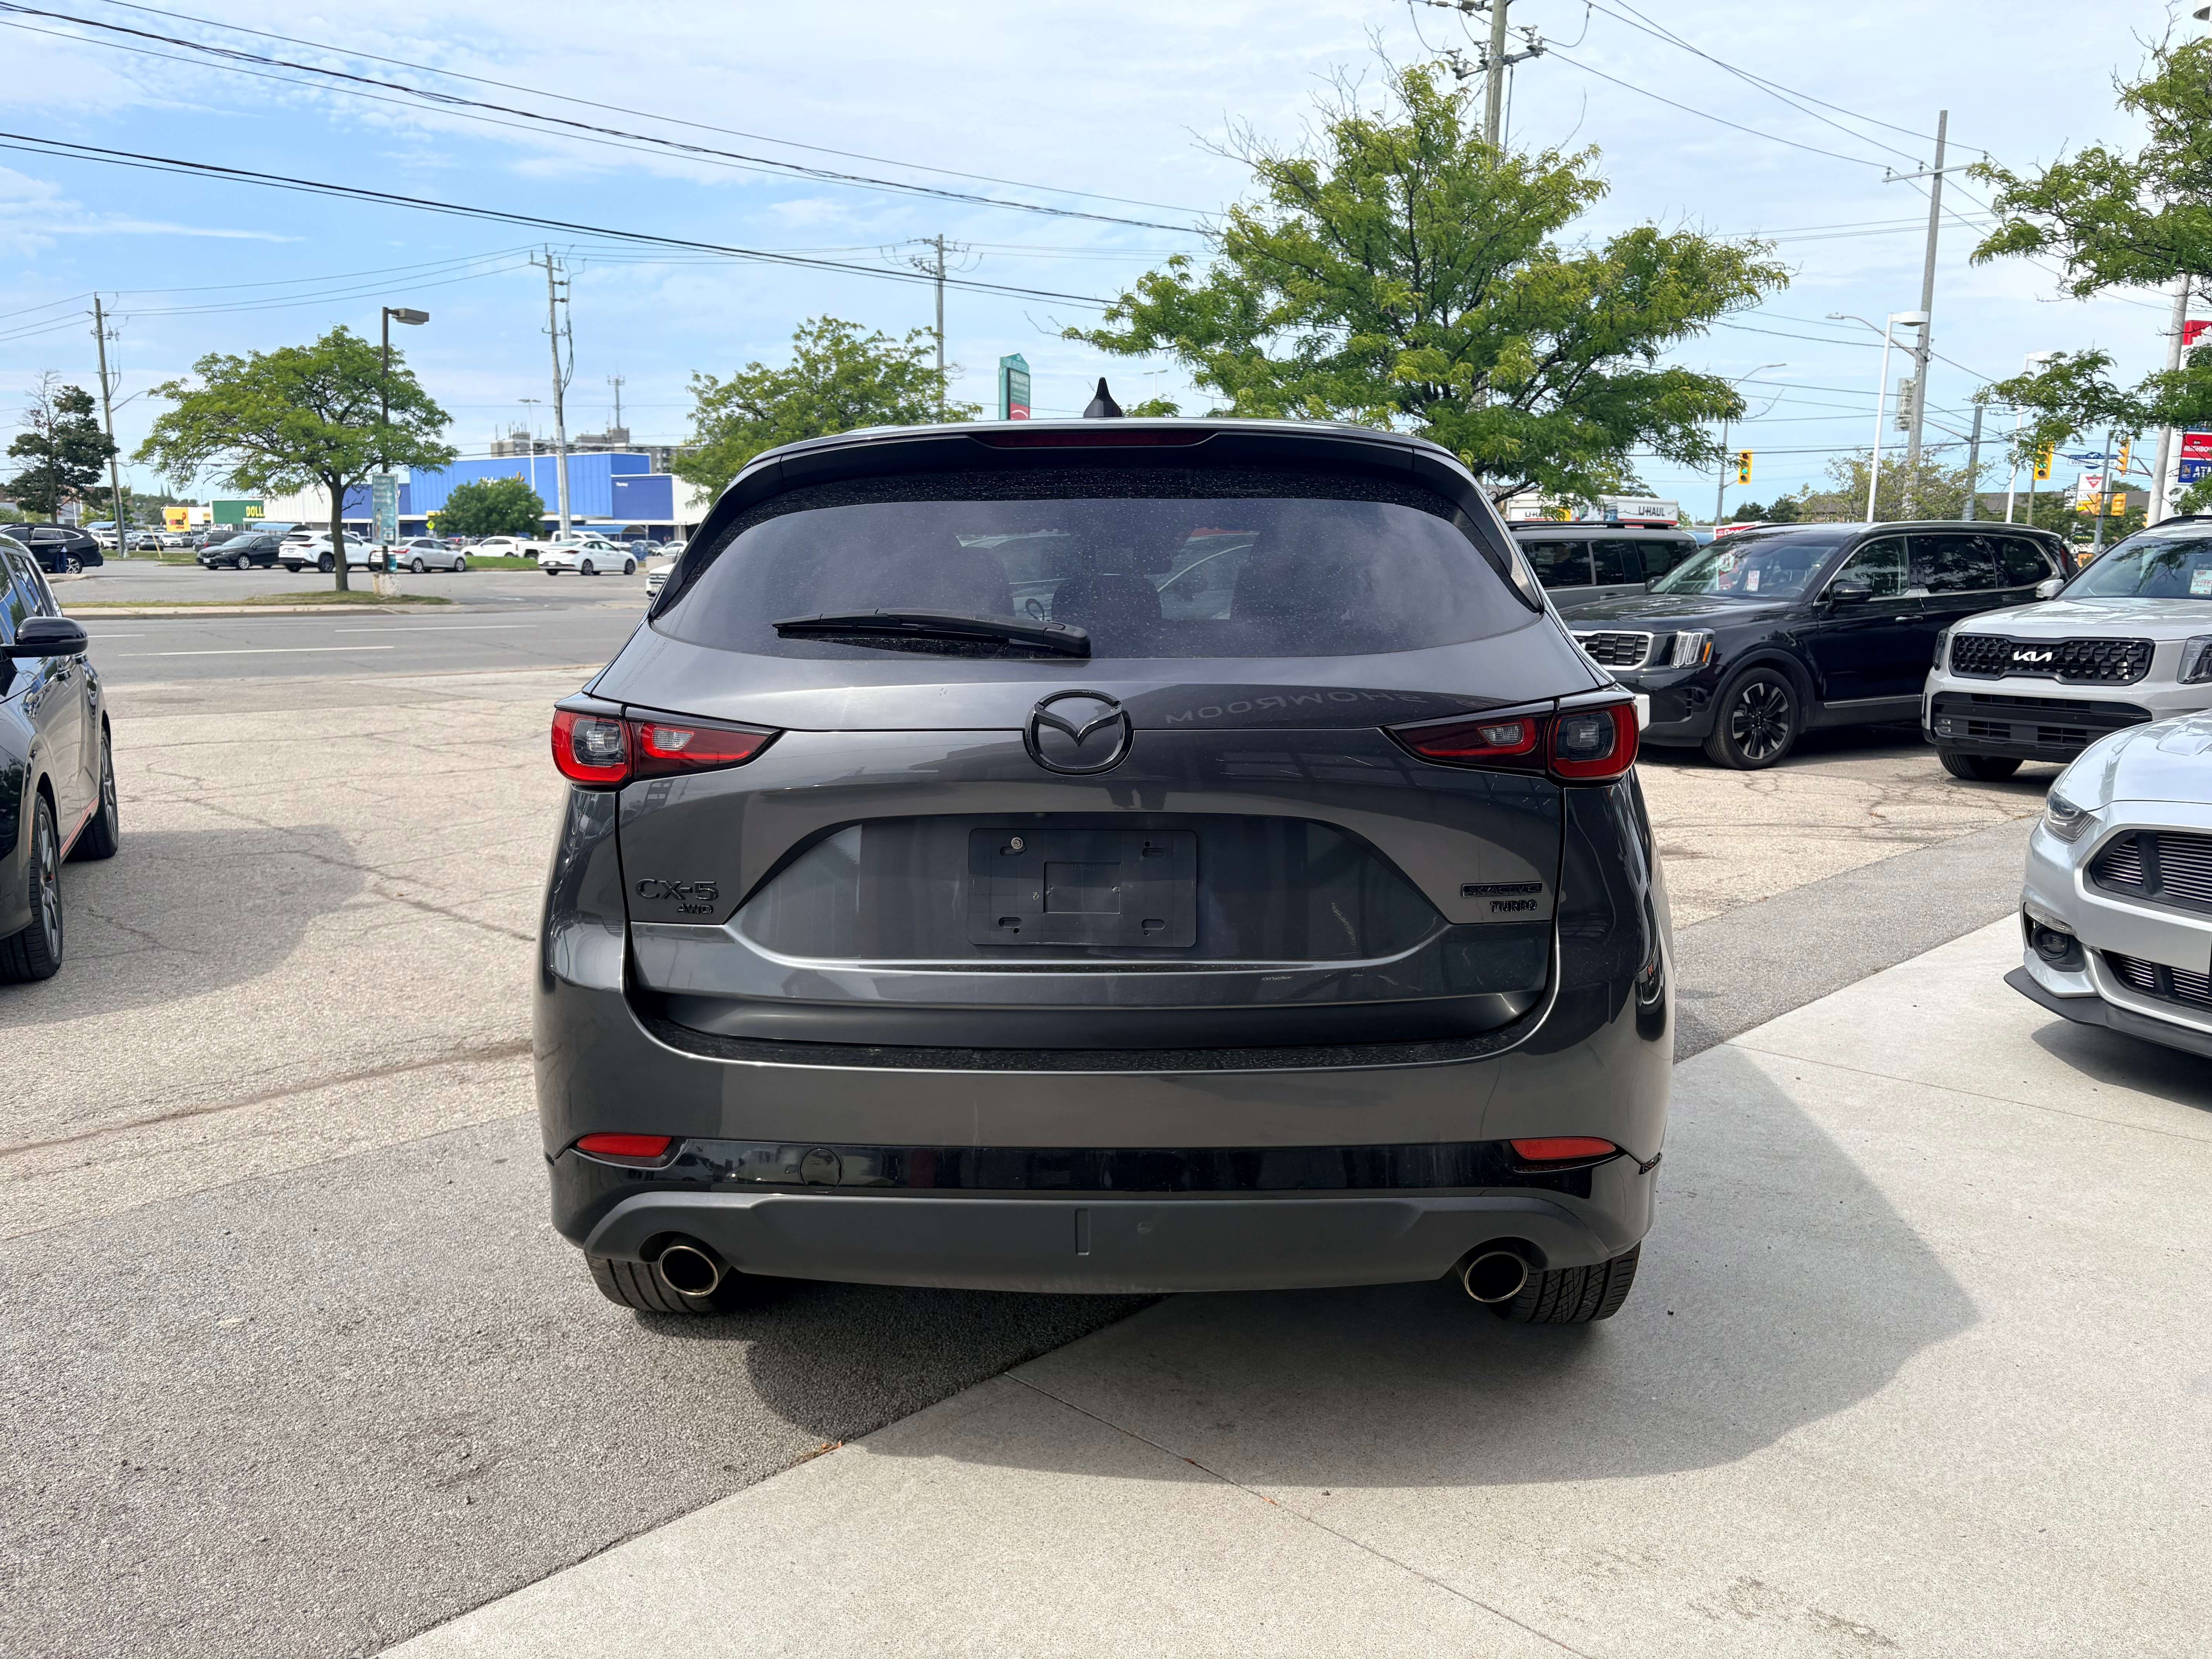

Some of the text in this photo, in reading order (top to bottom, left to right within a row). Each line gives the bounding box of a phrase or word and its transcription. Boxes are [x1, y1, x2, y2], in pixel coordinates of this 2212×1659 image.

[246, 505, 265, 517] DOLL
[1638, 506, 1666, 517] U-HAUL
[635, 878, 719, 900] CX-5
[676, 903, 714, 915] AWD
[1490, 899, 1537, 913] TURBO
